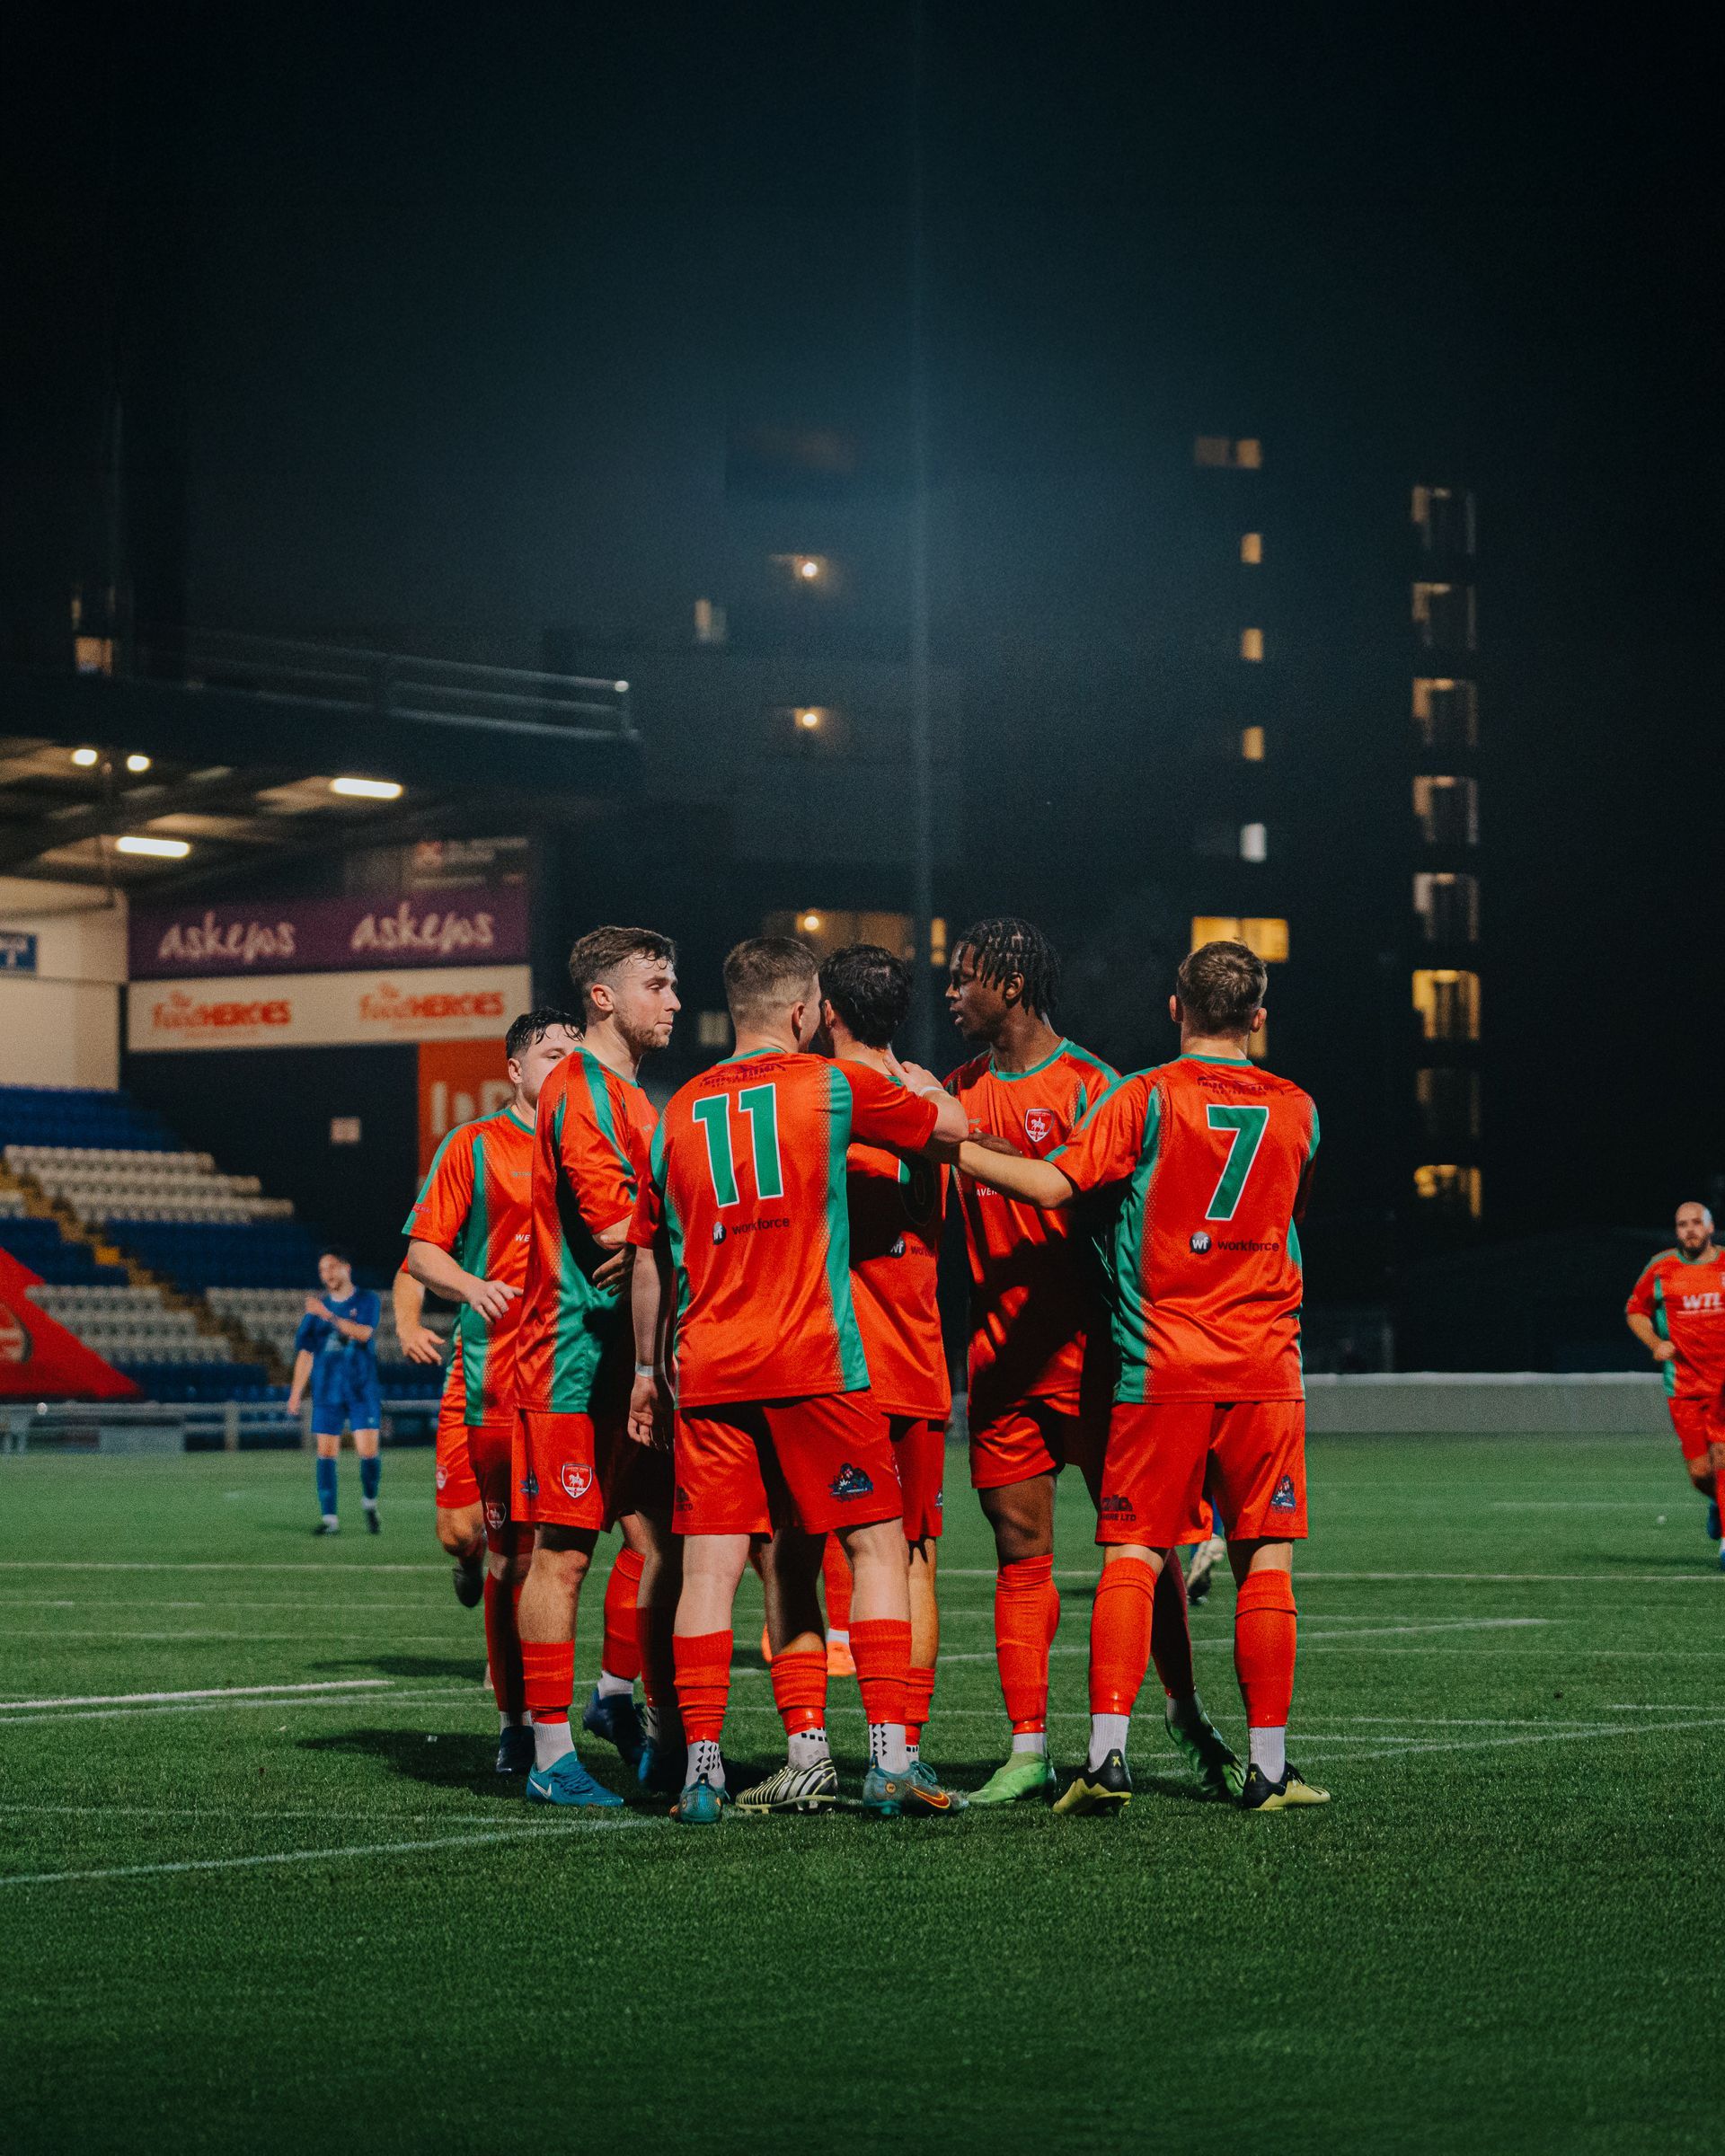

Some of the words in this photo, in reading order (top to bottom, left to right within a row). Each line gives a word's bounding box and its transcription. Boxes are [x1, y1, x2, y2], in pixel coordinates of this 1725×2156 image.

[693, 1082, 783, 1208] 11
[1206, 1104, 1269, 1221] 7
[731, 1217, 790, 1235] workforce
[1191, 1236, 1209, 1250] wf
[1217, 1240, 1279, 1252] workforce
